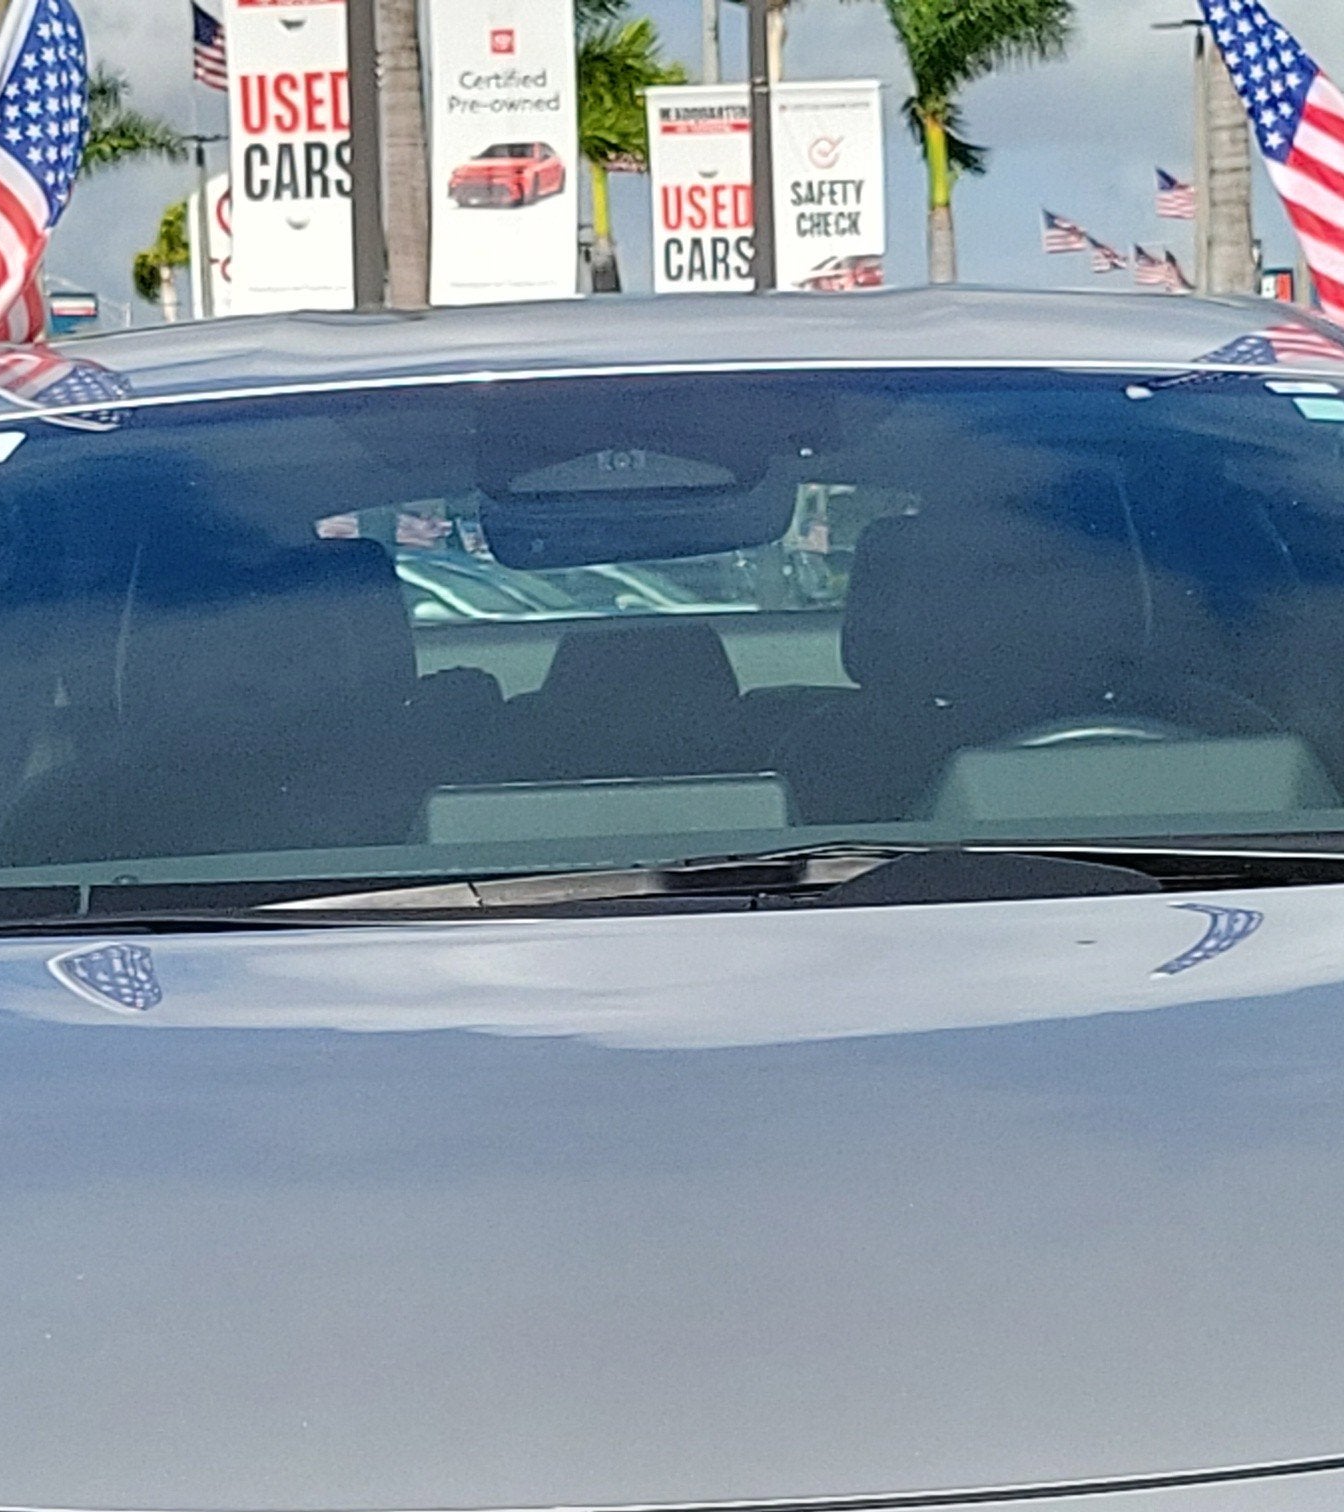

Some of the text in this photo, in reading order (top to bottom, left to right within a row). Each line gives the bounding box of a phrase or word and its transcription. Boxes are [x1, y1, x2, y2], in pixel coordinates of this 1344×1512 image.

[459, 69, 546, 89] Certified
[448, 92, 560, 113] Pre-owned
[243, 140, 354, 201] CARS
[790, 179, 864, 206] SAFETY
[662, 185, 754, 230] USED
[796, 211, 861, 238] CHECK
[664, 236, 754, 281] CARS
